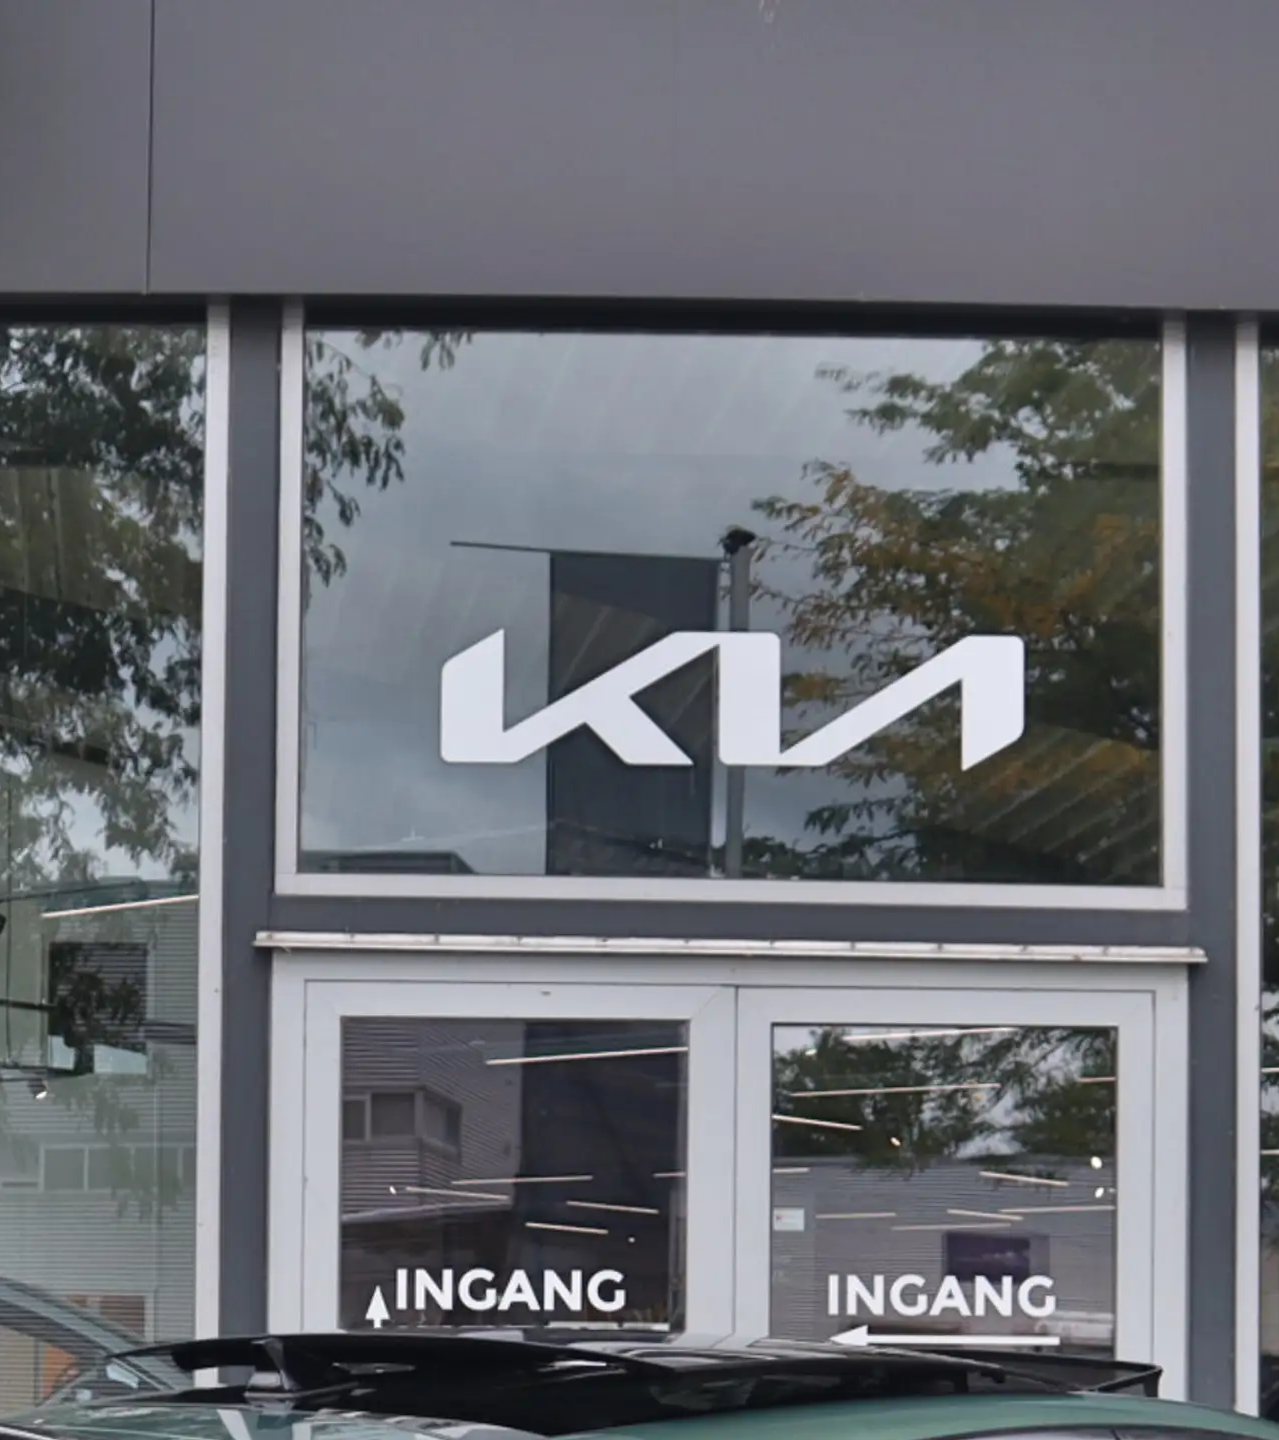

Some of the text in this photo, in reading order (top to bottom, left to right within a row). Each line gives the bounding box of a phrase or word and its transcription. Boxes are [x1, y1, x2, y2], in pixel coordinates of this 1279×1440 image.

[440, 629, 1025, 771] KIA
[395, 1268, 626, 1312] INGANG
[828, 1273, 1057, 1317] INGANG
